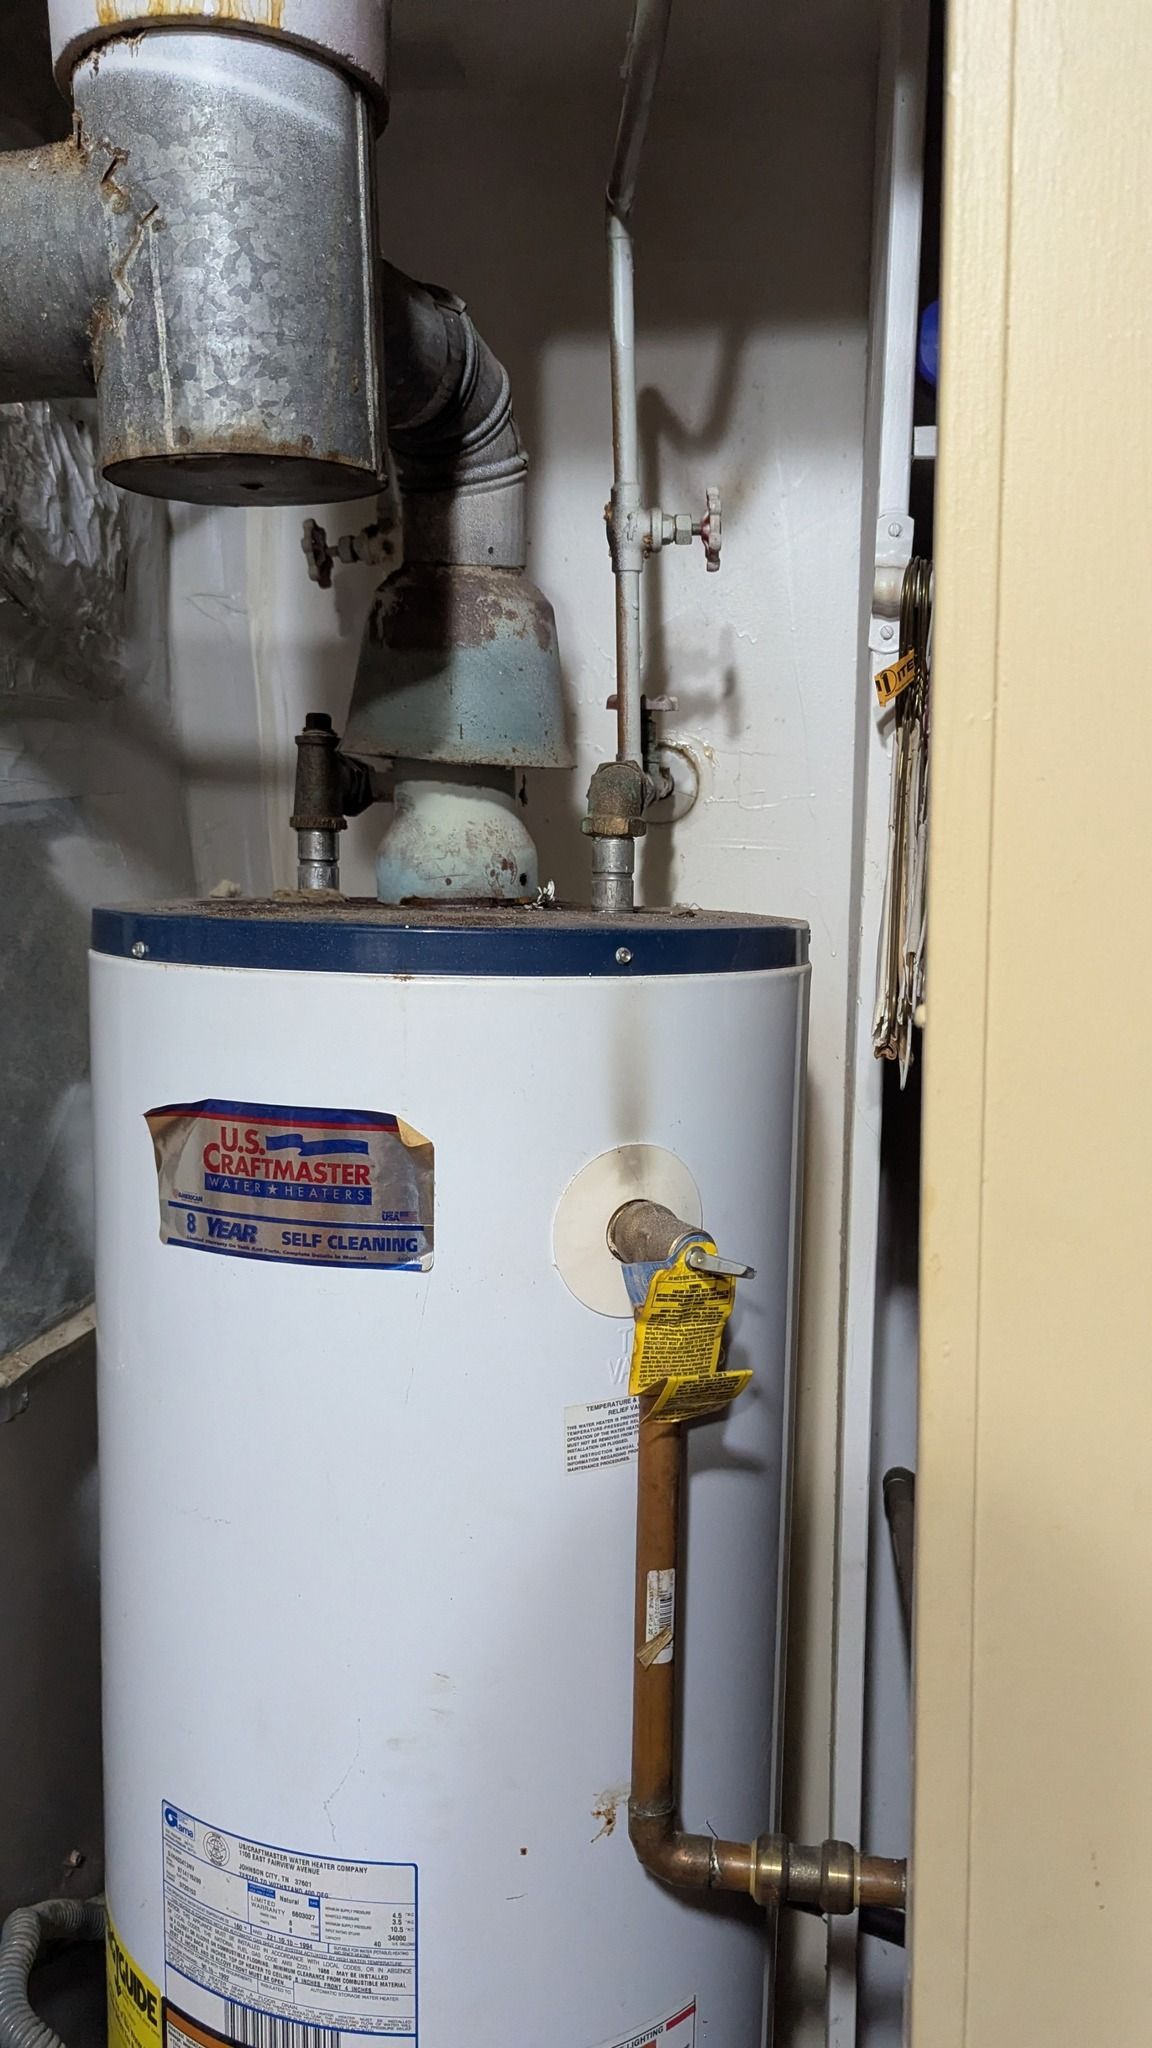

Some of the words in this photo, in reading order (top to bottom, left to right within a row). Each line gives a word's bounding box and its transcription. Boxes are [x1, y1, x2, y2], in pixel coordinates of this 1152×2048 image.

[221, 1127, 266, 1155] U.S.
[203, 1143, 371, 1186] CRAFTMASTER
[209, 1177, 261, 1193] WATER
[285, 1187, 364, 1200] HEATERS
[382, 1213, 400, 1222] USA
[187, 1213, 196, 1234] 8
[207, 1216, 258, 1243] YEAR
[282, 1231, 322, 1248] SELF
[327, 1235, 418, 1253] CLEANING
[586, 1398, 631, 1411] TEMPERATURE
[608, 1407, 629, 1416] RELIEF
[567, 1433, 593, 1442] OPERATION
[599, 1433, 620, 1442] REMOVED
[567, 1444, 599, 1454] INSTALLATION
[580, 1449, 612, 1458] INSTRUCTION
[615, 1444, 634, 1452] MANUAL
[567, 1458, 599, 1467] INFORMATION
[600, 1451, 626, 1460] REGARDING
[567, 1463, 599, 1472] MAINTENANCE
[239, 1850, 251, 1859] 1100
[252, 1853, 266, 1862] EAST
[267, 1857, 295, 1870] FAIRVIEW
[296, 1866, 320, 1875] AVENUE
[289, 1857, 310, 1866] WATER
[312, 1861, 335, 1870] HEATER
[337, 1865, 368, 1874] COMPANY
[238, 1864, 264, 1876] JOHNSON
[282, 1875, 290, 1883] TN
[295, 1879, 312, 1888] 37601
[238, 1872, 259, 1883] TESTED
[268, 1881, 303, 1893] WITHSTAND
[251, 1896, 276, 1907] LIMITED
[280, 1895, 300, 1905] Natural
[251, 1902, 285, 1917] WARRANTY
[214, 1928, 226, 1938] MUST
[237, 1938, 261, 1950] INSTALLED
[271, 1950, 304, 1963] ACCORDANCE
[307, 1957, 320, 1965] WITH
[323, 1961, 339, 1969] LOCAL
[300, 1942, 312, 1950] 1994
[217, 1943, 246, 1959] COMBUSTIBLE
[273, 1964, 296, 1975] MINIMUM
[297, 1970, 325, 1980] CLEARANCE
[326, 1974, 342, 1982] FROM
[342, 1976, 378, 1987] COMBUSTIBLE
[237, 1946, 248, 1954] FUEL
[251, 1950, 261, 1958] GAS
[264, 1955, 278, 1963] CODE
[336, 1970, 348, 1978] MAY
[358, 1972, 388, 1980] INSTALLED
[233, 1964, 248, 1974] FRONT
[248, 1970, 262, 1978] MUST
[270, 1978, 284, 1986] OPEN
[246, 1962, 264, 1973] HEATER
[272, 1972, 292, 1981] CEILING
[301, 1978, 320, 1988] INCHES
[324, 1982, 342, 1990] FRONT
[351, 1986, 372, 1994] INCHES
[310, 1988, 338, 1996] AUTOMATIC
[627, 2026, 664, 2048] LIGHTING
